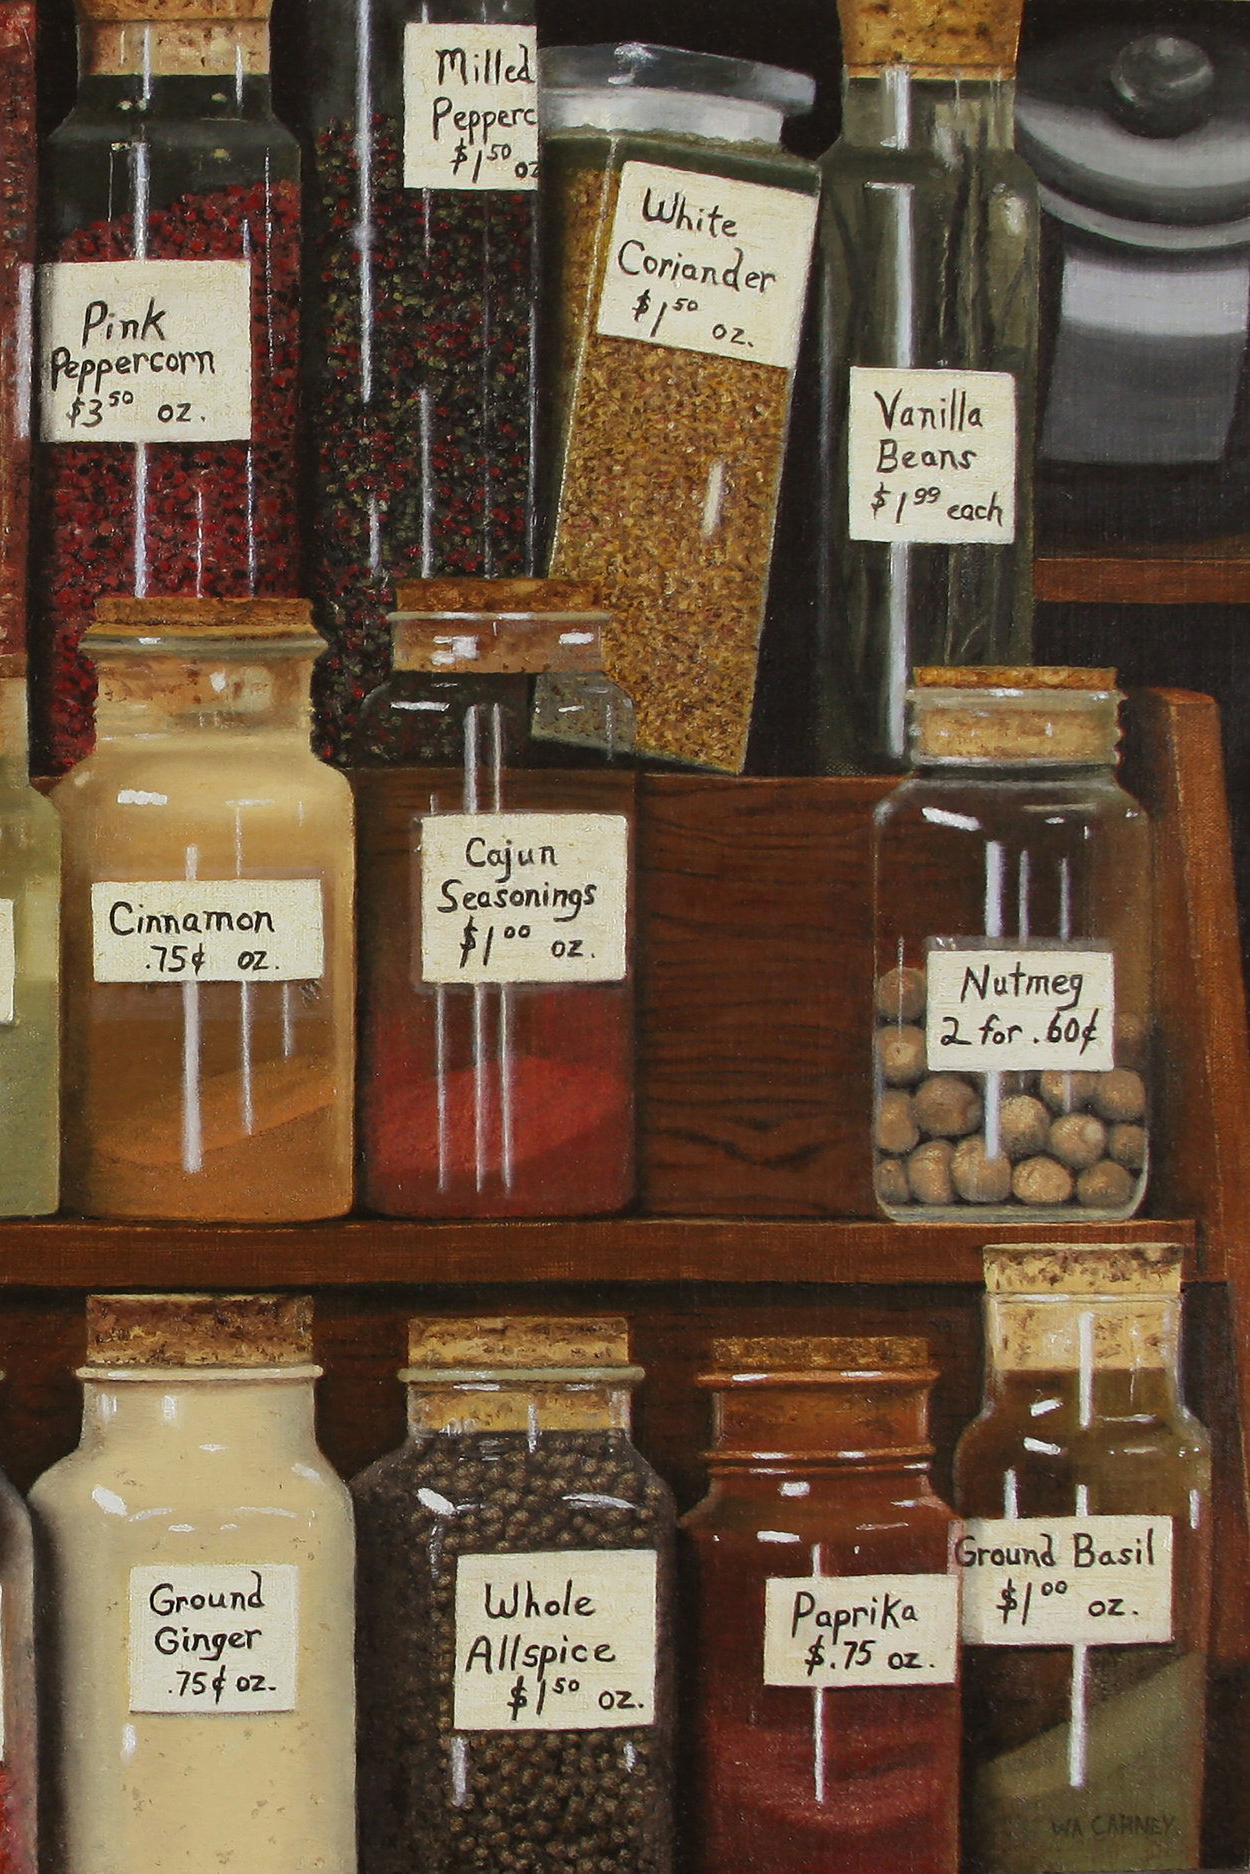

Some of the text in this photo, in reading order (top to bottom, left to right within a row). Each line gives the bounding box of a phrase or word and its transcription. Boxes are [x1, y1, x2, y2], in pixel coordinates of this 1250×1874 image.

[435, 43, 536, 86] Milled
[642, 187, 738, 238] White
[617, 239, 777, 294] Coriander
[81, 296, 167, 349] Pink
[712, 323, 754, 348] oz.
[49, 346, 216, 396] Peppercorn
[157, 402, 206, 424] oz.
[873, 388, 983, 432] Vanilla
[876, 438, 977, 474] Beans
[946, 491, 1003, 527] each
[465, 836, 559, 887] Cajun
[109, 901, 275, 937] Cinnamon
[436, 878, 598, 923] Seasonings
[145, 942, 280, 976] .75¢ oz.
[550, 939, 596, 959] oz.
[960, 961, 1084, 1012] Nutmeg
[940, 1007, 1100, 1056] 2 for .60¢
[953, 1527, 1154, 1569] Ground Basil
[149, 1570, 265, 1617] Ground
[484, 1578, 596, 1620] Whole
[1087, 1598, 1139, 1618] oz.
[791, 1590, 919, 1646] Paprika
[154, 1625, 263, 1662] Ginger
[465, 1633, 616, 1683] Allspice
[887, 1651, 935, 1671] oz.
[168, 1664, 277, 1705] .75¢ oz.
[598, 1690, 645, 1711] oz.
